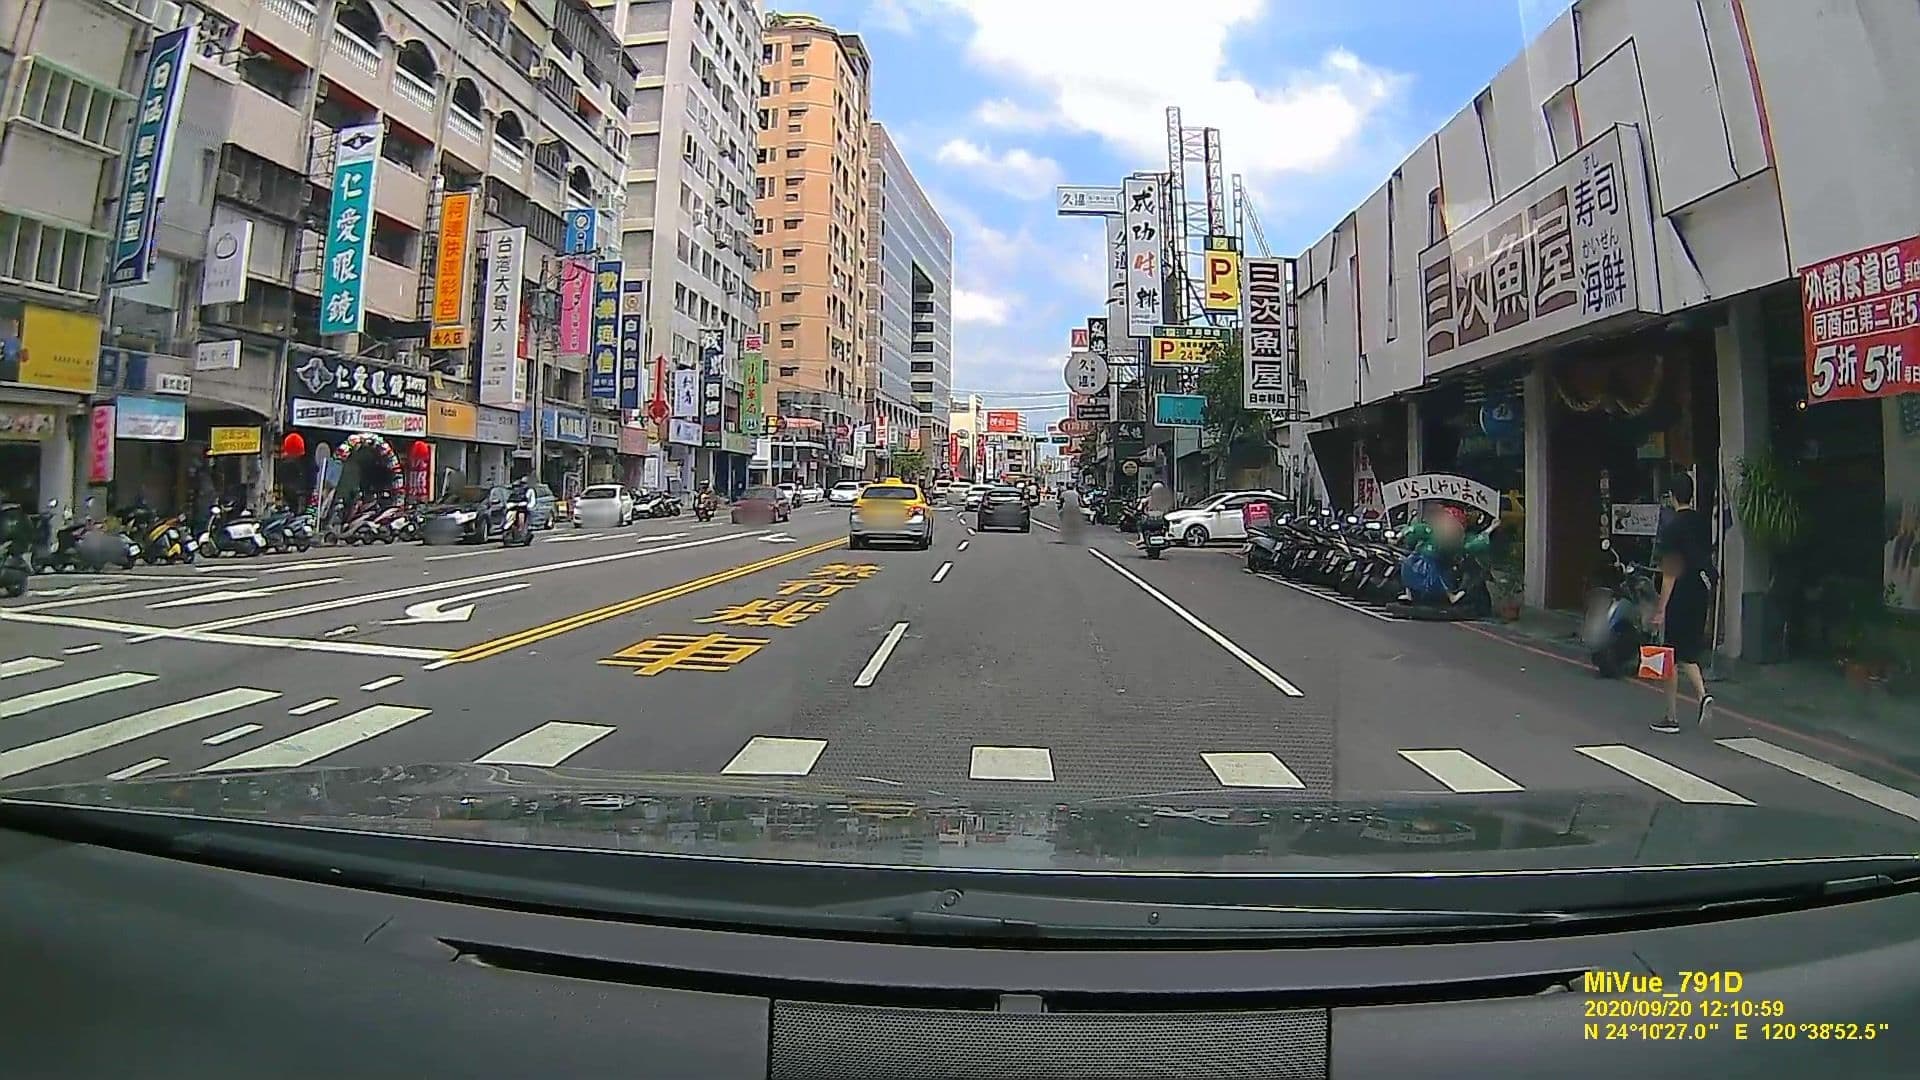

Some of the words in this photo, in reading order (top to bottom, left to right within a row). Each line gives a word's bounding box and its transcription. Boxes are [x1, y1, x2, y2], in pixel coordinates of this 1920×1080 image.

[1574, 163, 1618, 227] 寿司
[327, 171, 363, 324] 仁愛眼鏡
[1211, 258, 1231, 285] P
[1805, 246, 1902, 311] 外帶便當區
[1580, 247, 1626, 315] 海鮮
[1160, 340, 1175, 360] P
[1811, 344, 1857, 397] 5折
[1862, 344, 1902, 393] 5折
